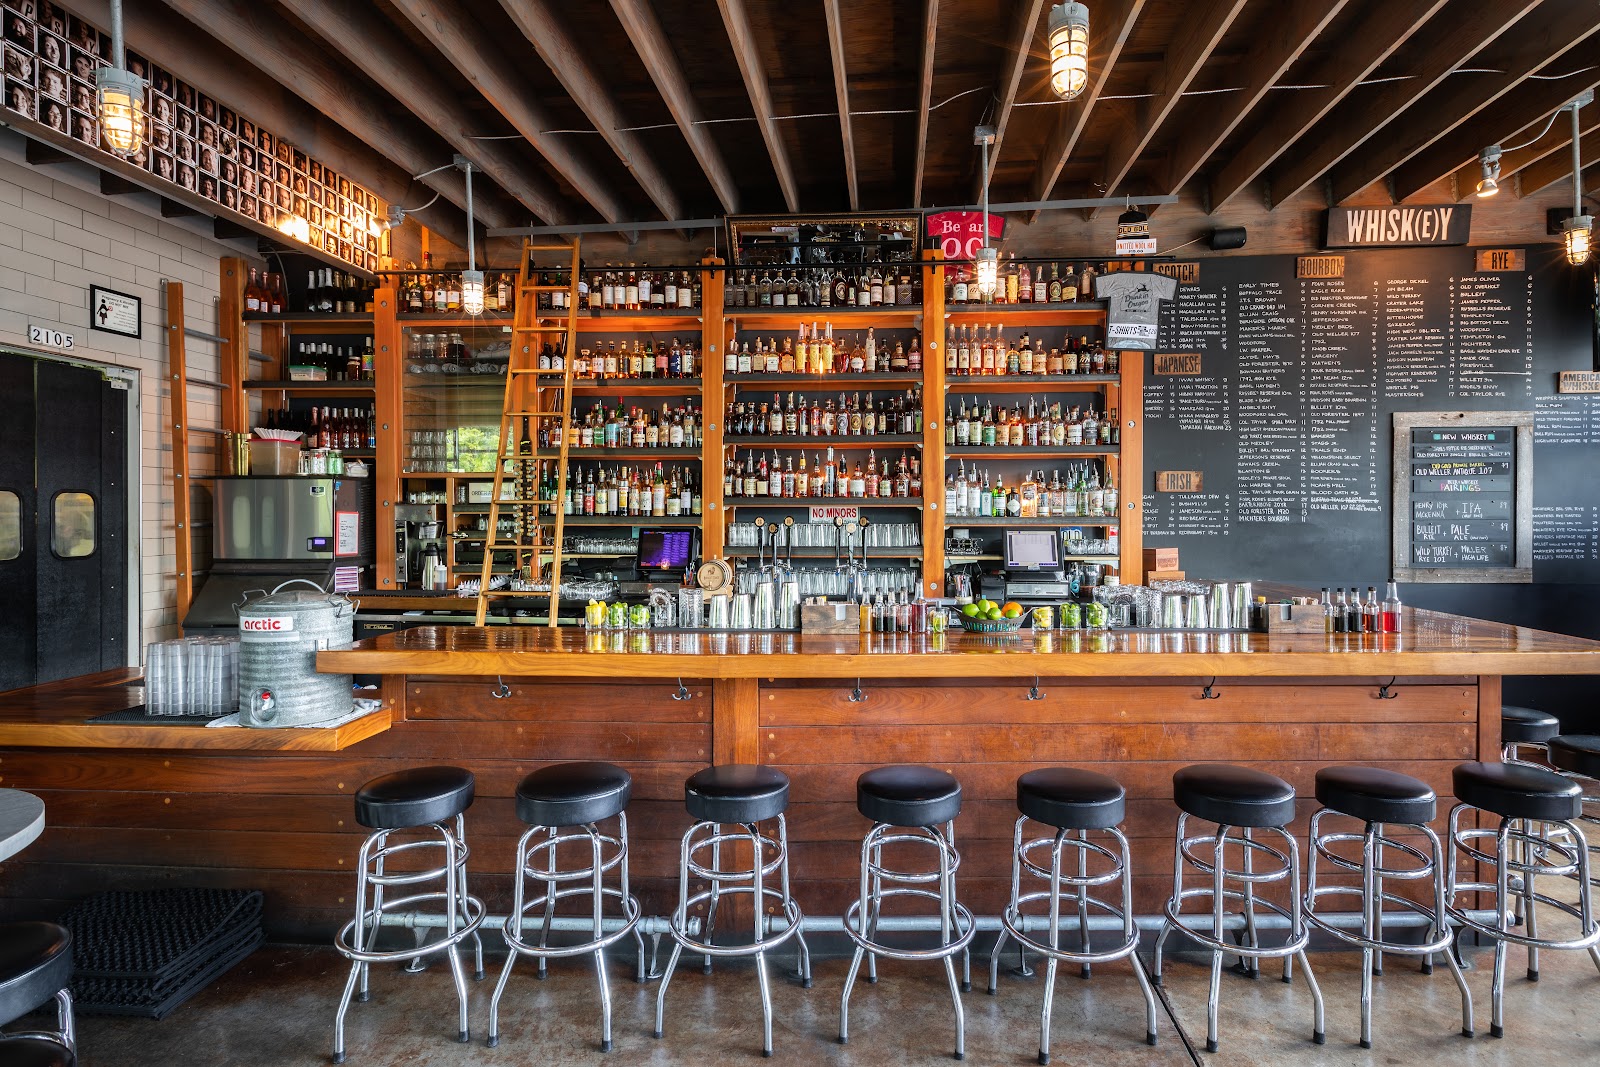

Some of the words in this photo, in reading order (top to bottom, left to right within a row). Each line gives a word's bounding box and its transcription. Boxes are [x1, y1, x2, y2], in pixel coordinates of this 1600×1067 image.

[942, 220, 960, 234] Be
[1347, 207, 1453, 242] WHISK(E)Y
[1300, 258, 1345, 276] BOURBON
[1492, 252, 1509, 269] RYE
[1109, 325, 1138, 335] T-SHIRTS
[32, 328, 73, 347] 2105
[1158, 356, 1199, 373] JAPANESE
[1461, 433, 1488, 441] WHISKEY
[1415, 468, 1428, 476] OLD
[1428, 468, 1451, 476] WELLER
[1452, 468, 1476, 476] ANTIQUE
[1478, 467, 1492, 475] 107
[1166, 473, 1192, 490] IRISH
[1440, 484, 1481, 492] PAIRINGS
[812, 508, 824, 518] NO
[826, 508, 857, 518] MINORS
[1415, 502, 1434, 510] HENRY
[1461, 502, 1482, 514] IPA
[1499, 501, 1508, 509] $9
[1416, 524, 1441, 535] BULLEIT
[1450, 523, 1471, 535] PALE
[1500, 522, 1509, 532] $9
[1415, 546, 1431, 556] WILD
[1432, 545, 1453, 557] TURKEY
[1460, 544, 1487, 554] MILLER
[1476, 554, 1490, 562] LIFE
[244, 618, 281, 630] arctic
